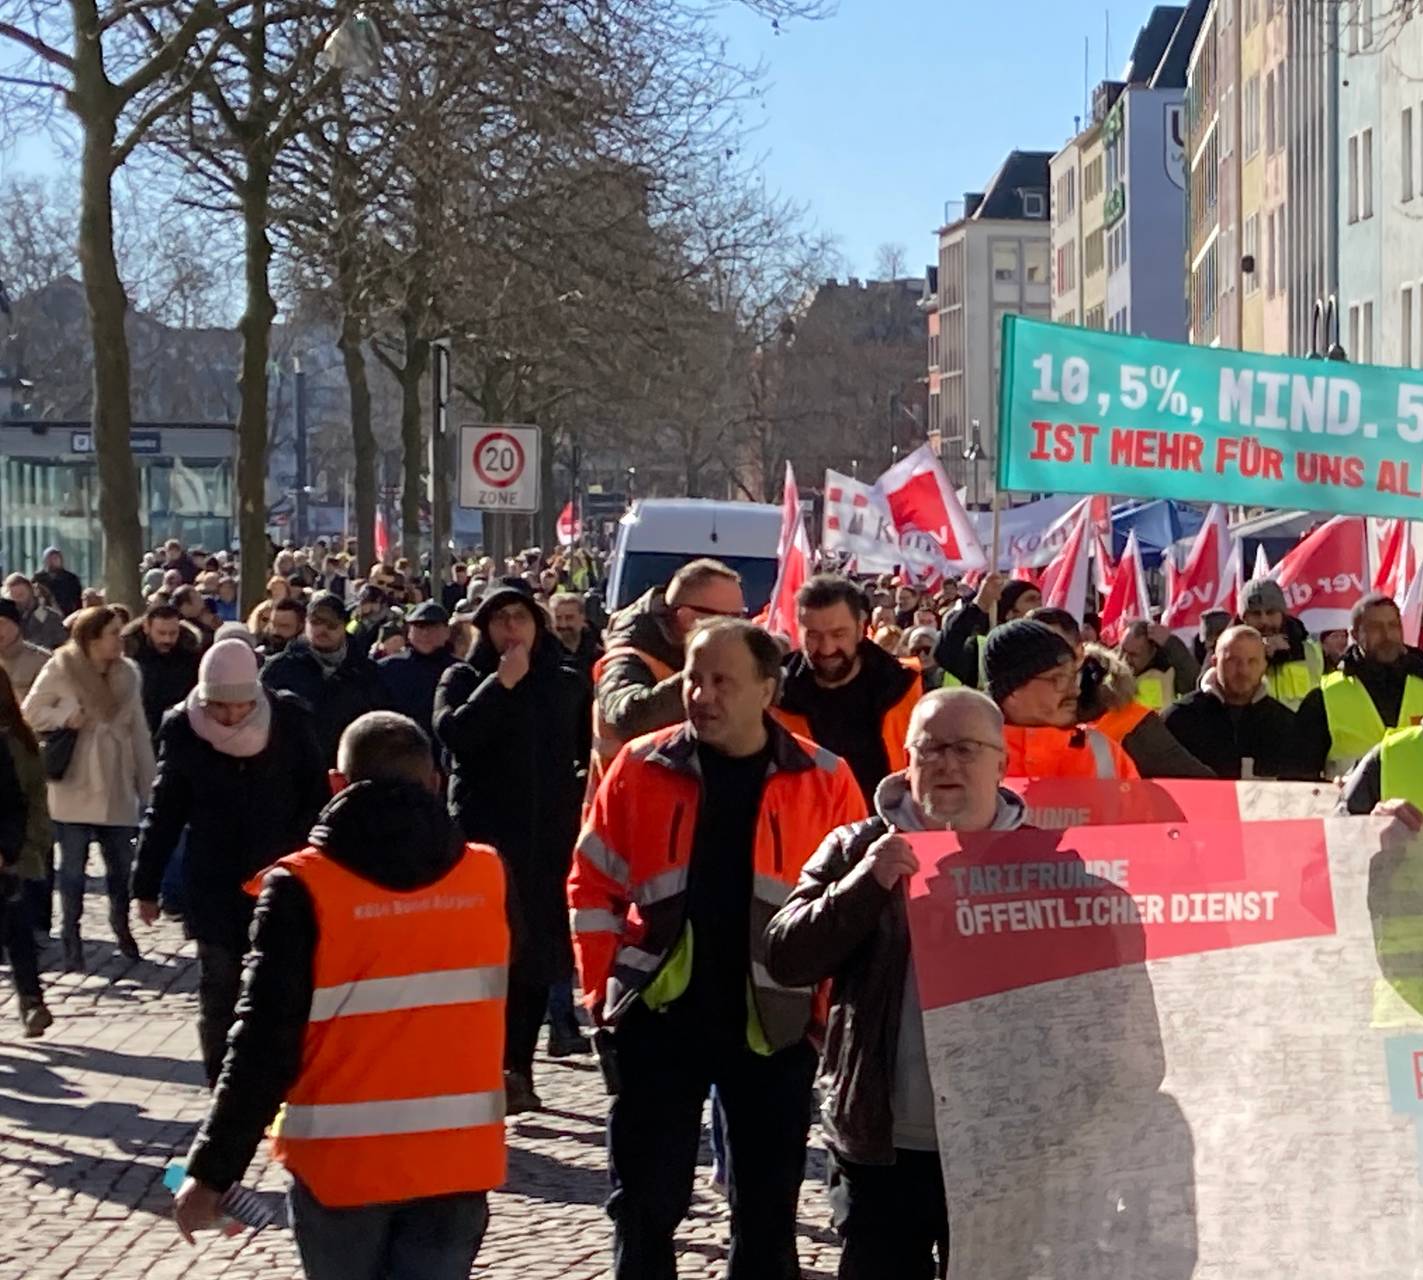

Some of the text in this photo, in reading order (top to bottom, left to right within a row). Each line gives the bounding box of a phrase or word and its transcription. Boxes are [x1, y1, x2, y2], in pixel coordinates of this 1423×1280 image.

[1031, 353, 1204, 425] 10,5%,
[1218, 367, 1379, 438] MIND.
[485, 447, 515, 472] 20
[1030, 421, 1099, 464] IST
[1110, 428, 1204, 473] MEHR
[1216, 436, 1284, 480] FÜR
[1296, 451, 1365, 488] UNS
[478, 491, 519, 505] ZONE
[950, 859, 1130, 896] TARIFRUNDE
[956, 891, 1279, 937] ÖFFENTLICHER DIENST
